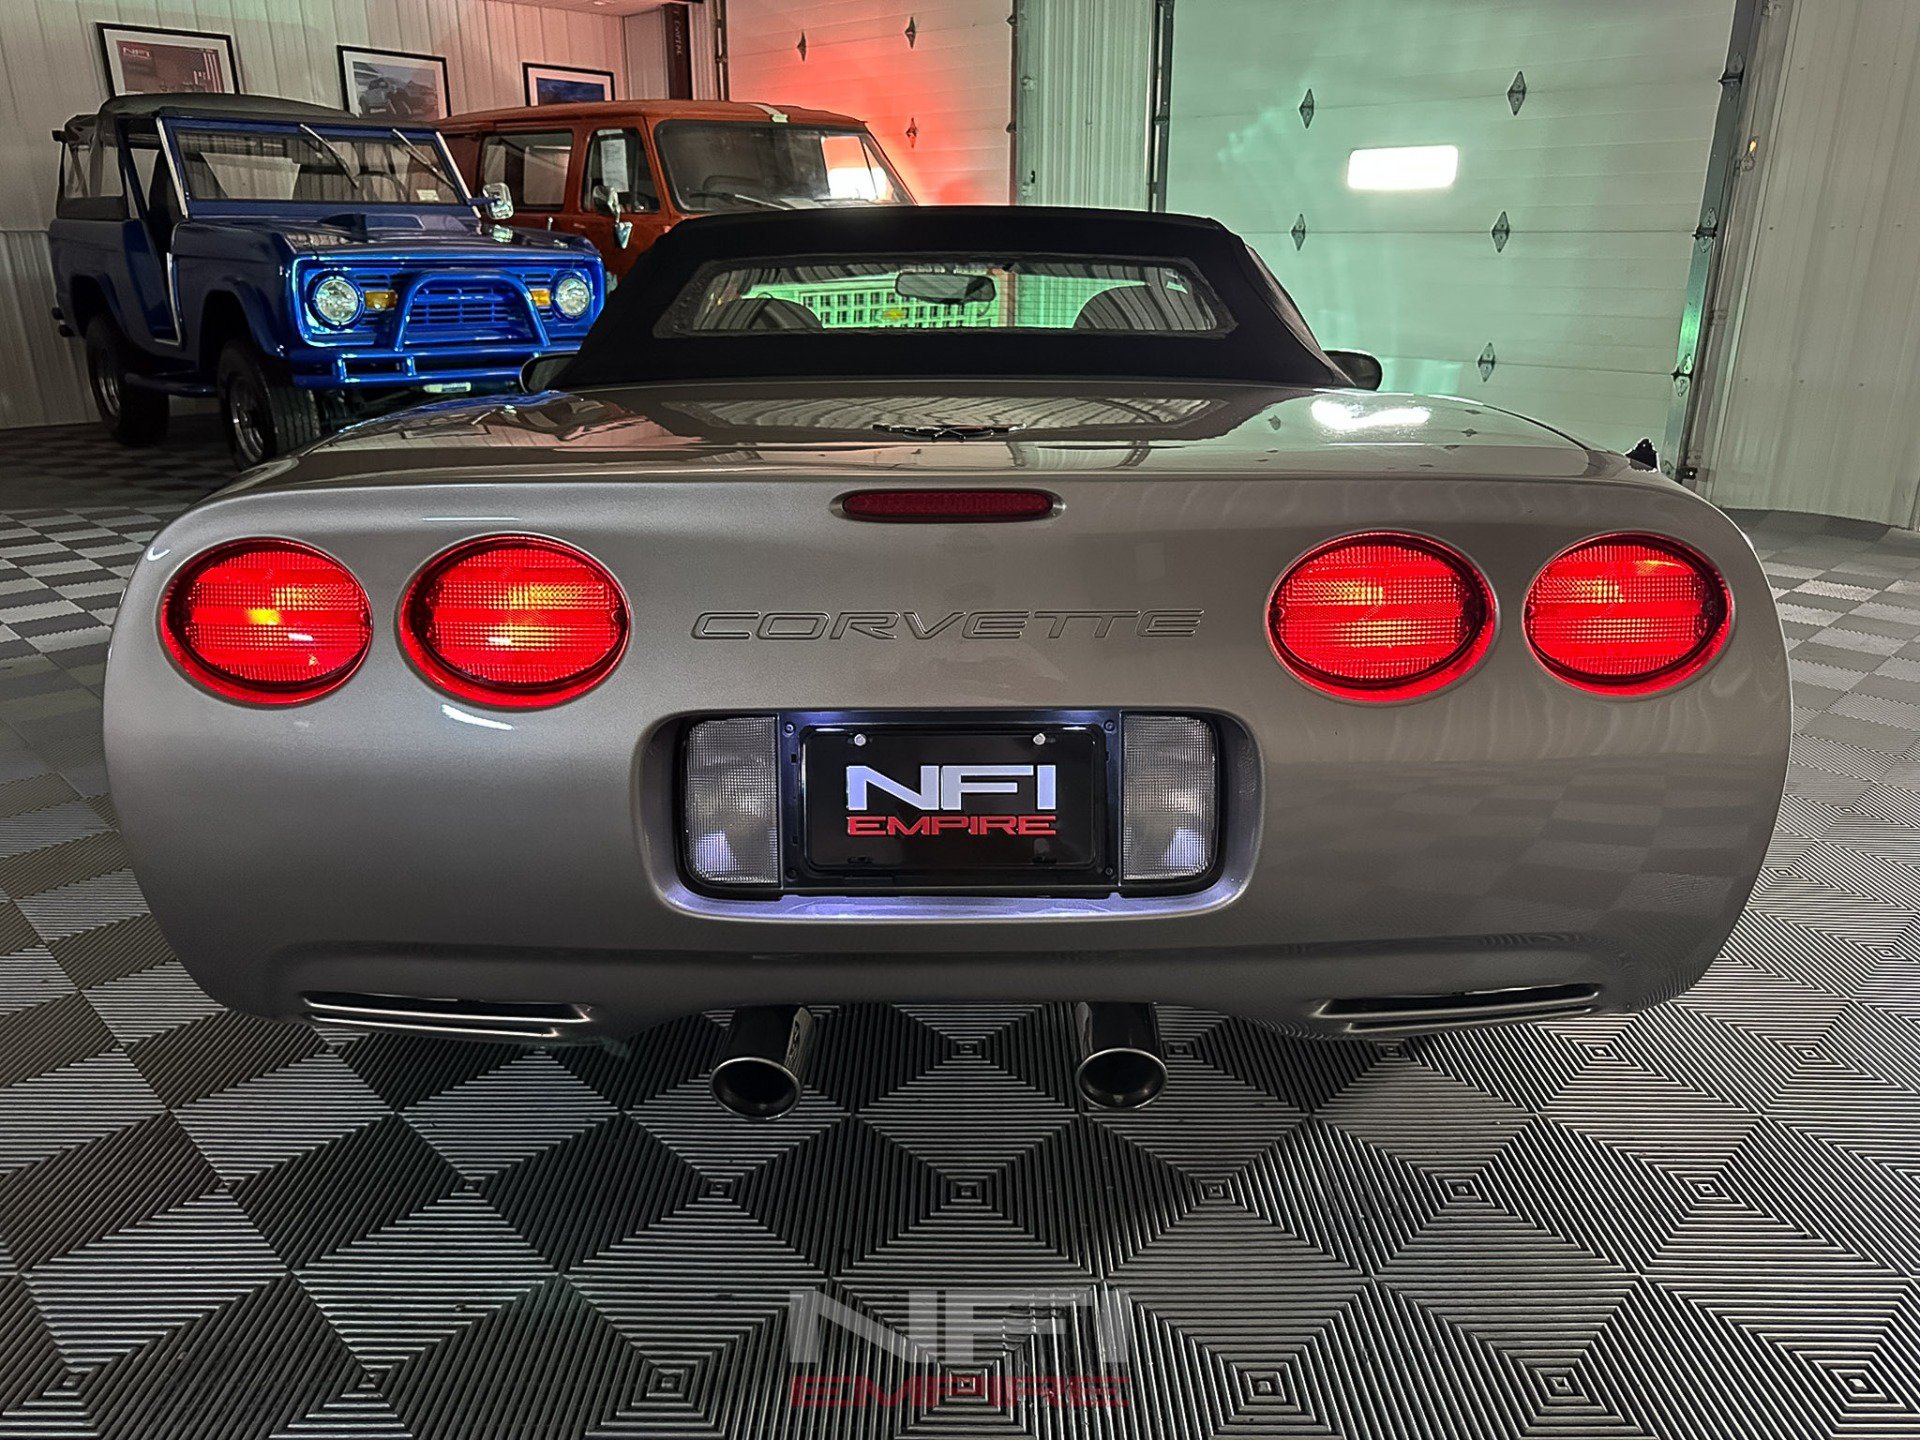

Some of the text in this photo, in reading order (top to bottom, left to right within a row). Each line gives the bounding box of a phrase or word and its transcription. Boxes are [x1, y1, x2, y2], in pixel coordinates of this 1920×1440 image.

[691, 610, 1204, 639] CORVETTE
[846, 765, 1056, 810] NFI
[846, 816, 1056, 835] EMPIRE
